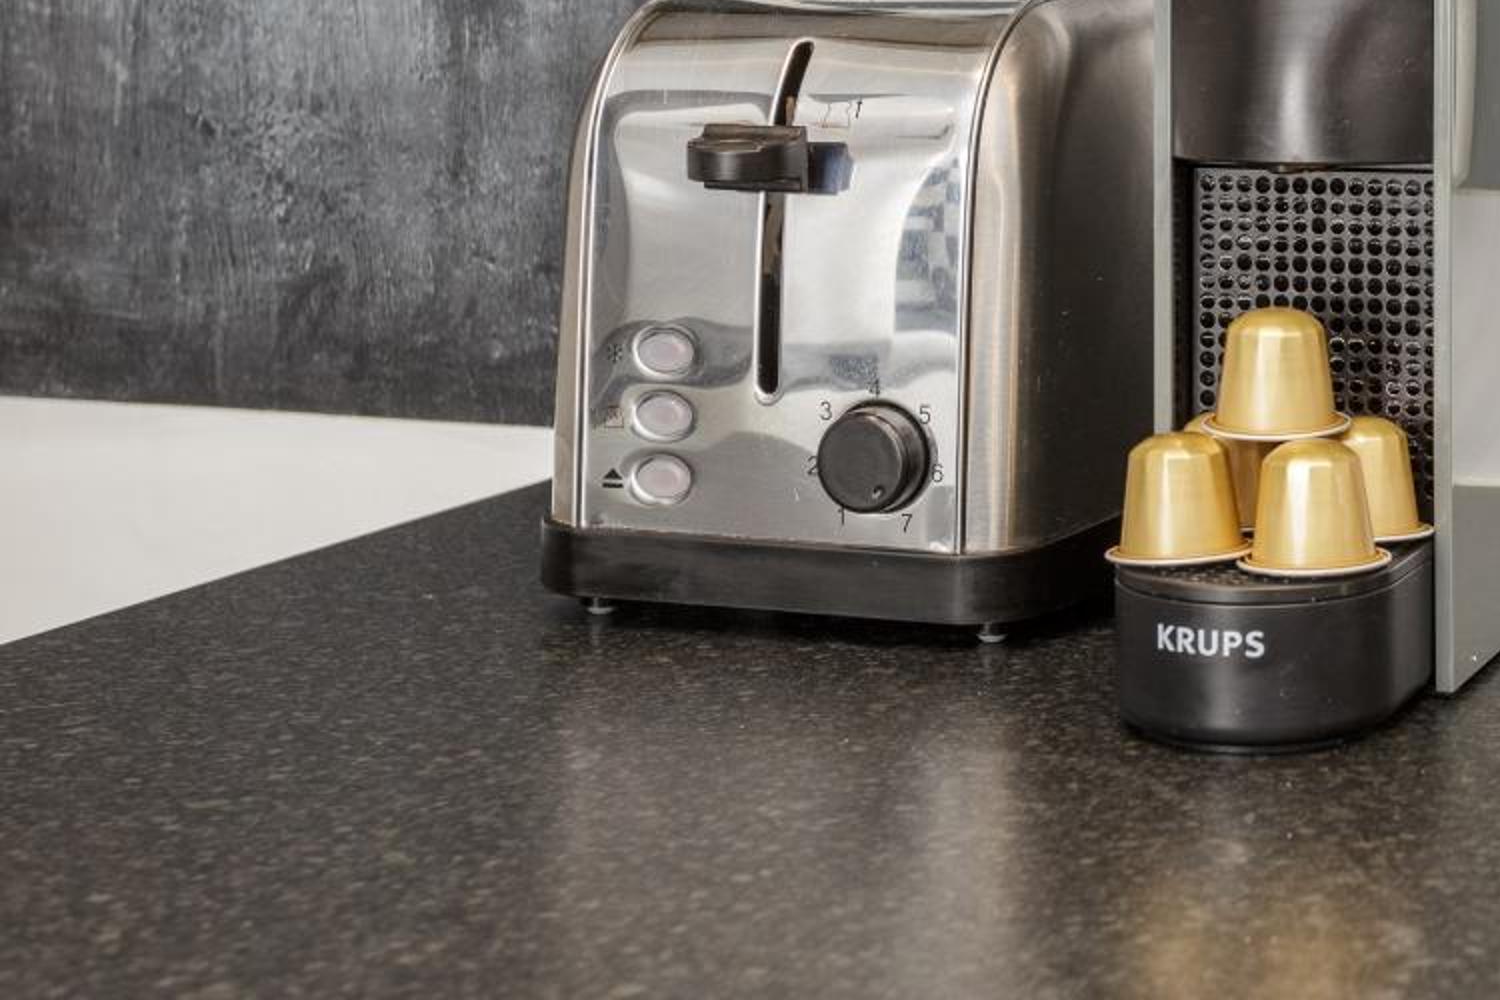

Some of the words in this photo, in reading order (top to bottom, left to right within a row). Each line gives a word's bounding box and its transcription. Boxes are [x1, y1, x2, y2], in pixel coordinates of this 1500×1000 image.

[820, 401, 833, 421] 3
[919, 405, 932, 425] 5
[807, 455, 819, 476] 2
[931, 463, 944, 483] 6
[838, 505, 845, 526] 1
[901, 513, 913, 533] 7
[1157, 622, 1266, 659] KRUPS
